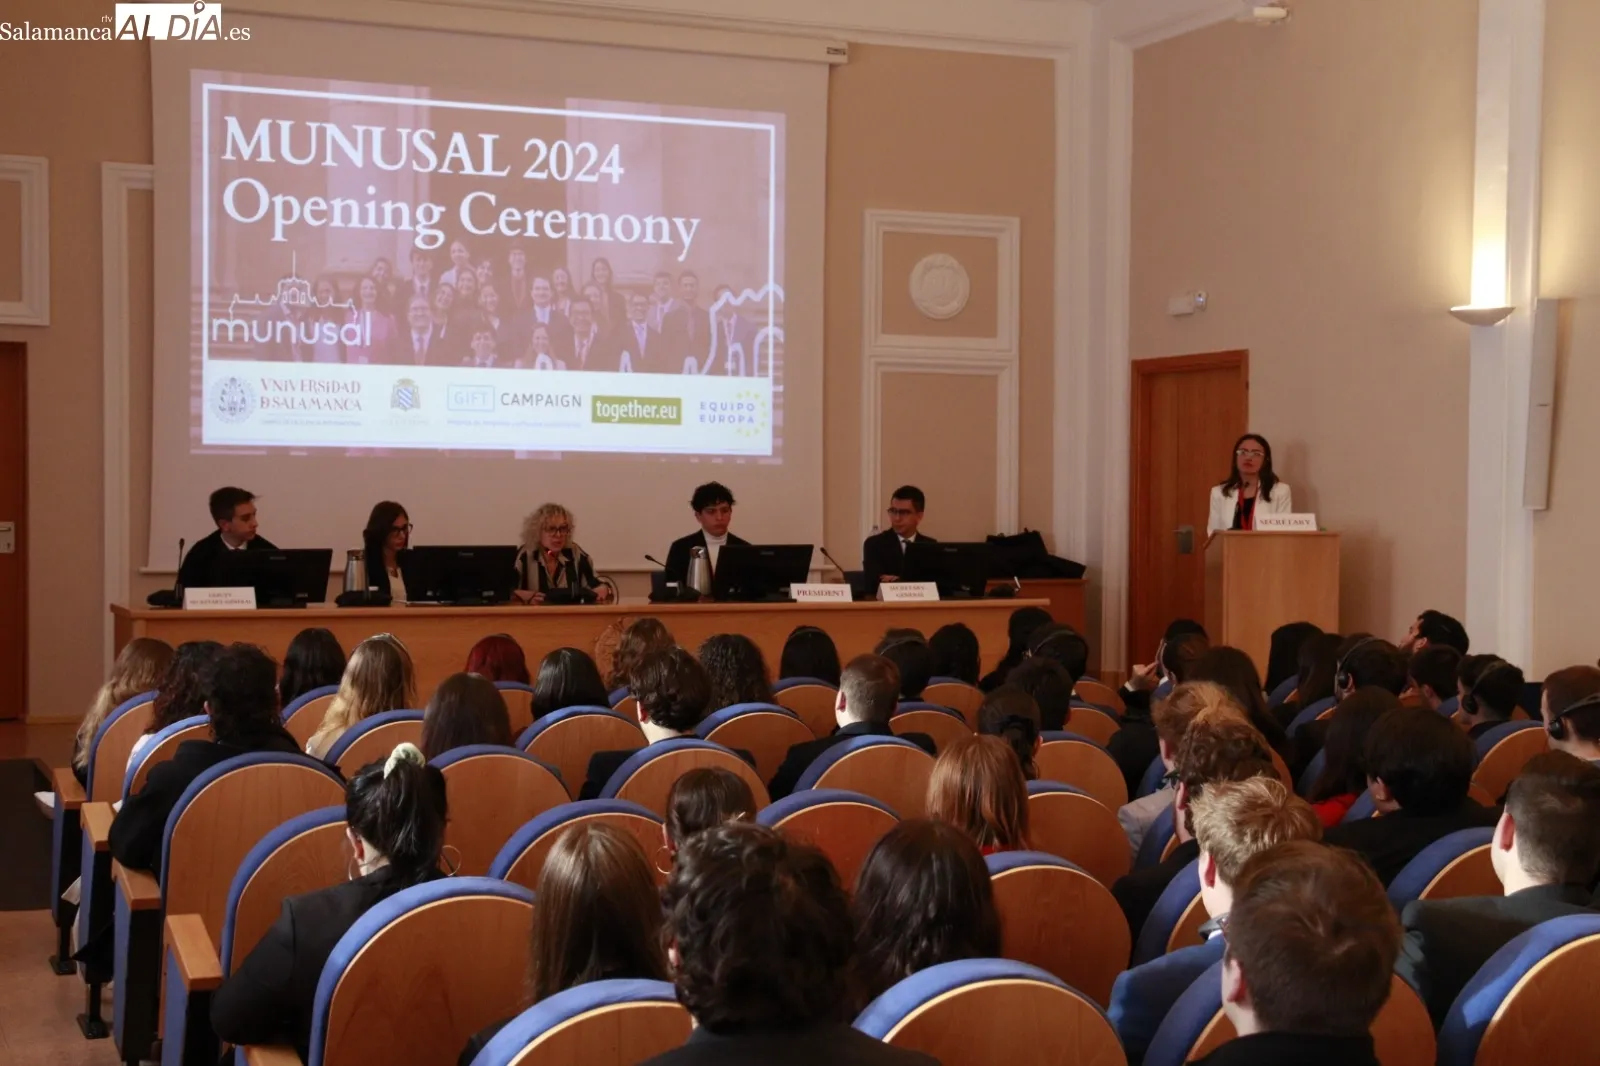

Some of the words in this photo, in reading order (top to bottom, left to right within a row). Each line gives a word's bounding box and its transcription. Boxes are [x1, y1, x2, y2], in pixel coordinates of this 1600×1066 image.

[221, 116, 511, 177] MUNUSAL
[523, 138, 625, 185] 2024
[223, 177, 446, 250] Opening
[459, 191, 701, 262] Ceremony
[212, 311, 372, 346] munusal
[453, 390, 489, 406] GIFT
[500, 392, 582, 408] CAMPAIGN
[595, 399, 678, 423] together.eu
[699, 401, 756, 412] EQUIPO
[699, 414, 756, 424] EUROPA
